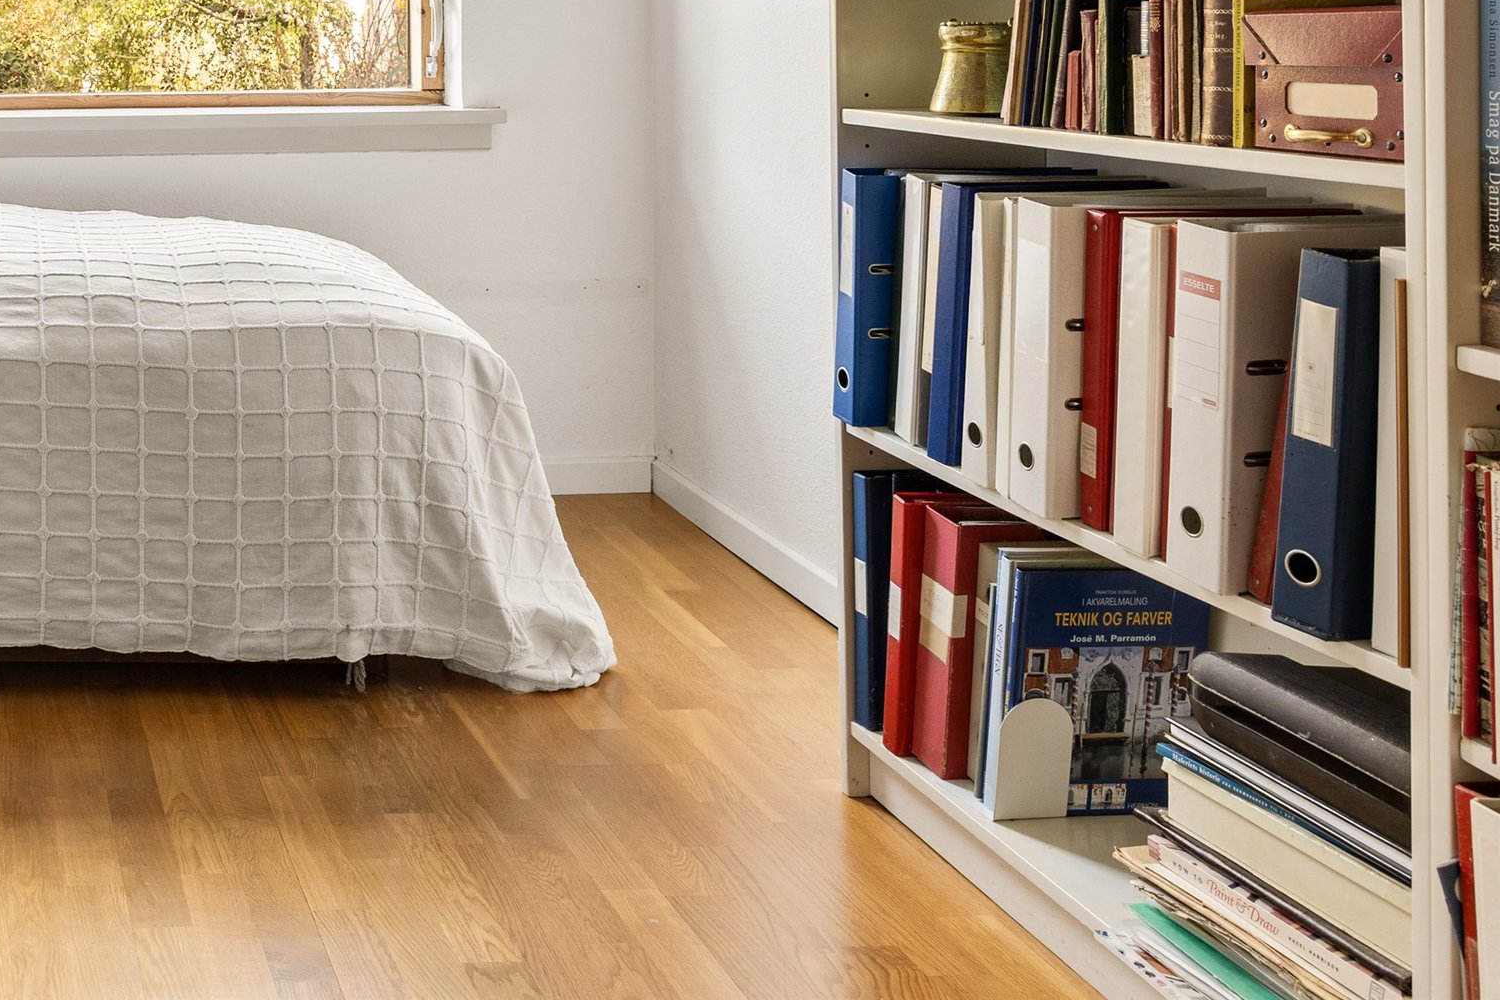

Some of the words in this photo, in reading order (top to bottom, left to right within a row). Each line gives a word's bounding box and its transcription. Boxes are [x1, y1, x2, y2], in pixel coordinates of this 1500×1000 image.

[1489, 19, 1499, 78] Simonsen
[1486, 90, 1500, 139] Smag
[1489, 171, 1500, 253] Danmark
[1183, 277, 1215, 293] ESSELTE
[1086, 596, 1148, 607] AKVARELMALING
[1054, 612, 1099, 627] TEKNIK
[1103, 611, 1122, 626] OG
[1126, 611, 1173, 626] FARVER
[1070, 634, 1092, 643] José
[1095, 635, 1107, 643] M.
[1110, 634, 1157, 643] Parramón
[1172, 753, 1198, 772] Maleriets
[1198, 764, 1221, 784] historie
[1172, 860, 1189, 875] HOW
[1193, 873, 1203, 884] TO
[1206, 878, 1237, 907] Paint
[1235, 898, 1248, 914] &
[1247, 904, 1280, 936] Draw
